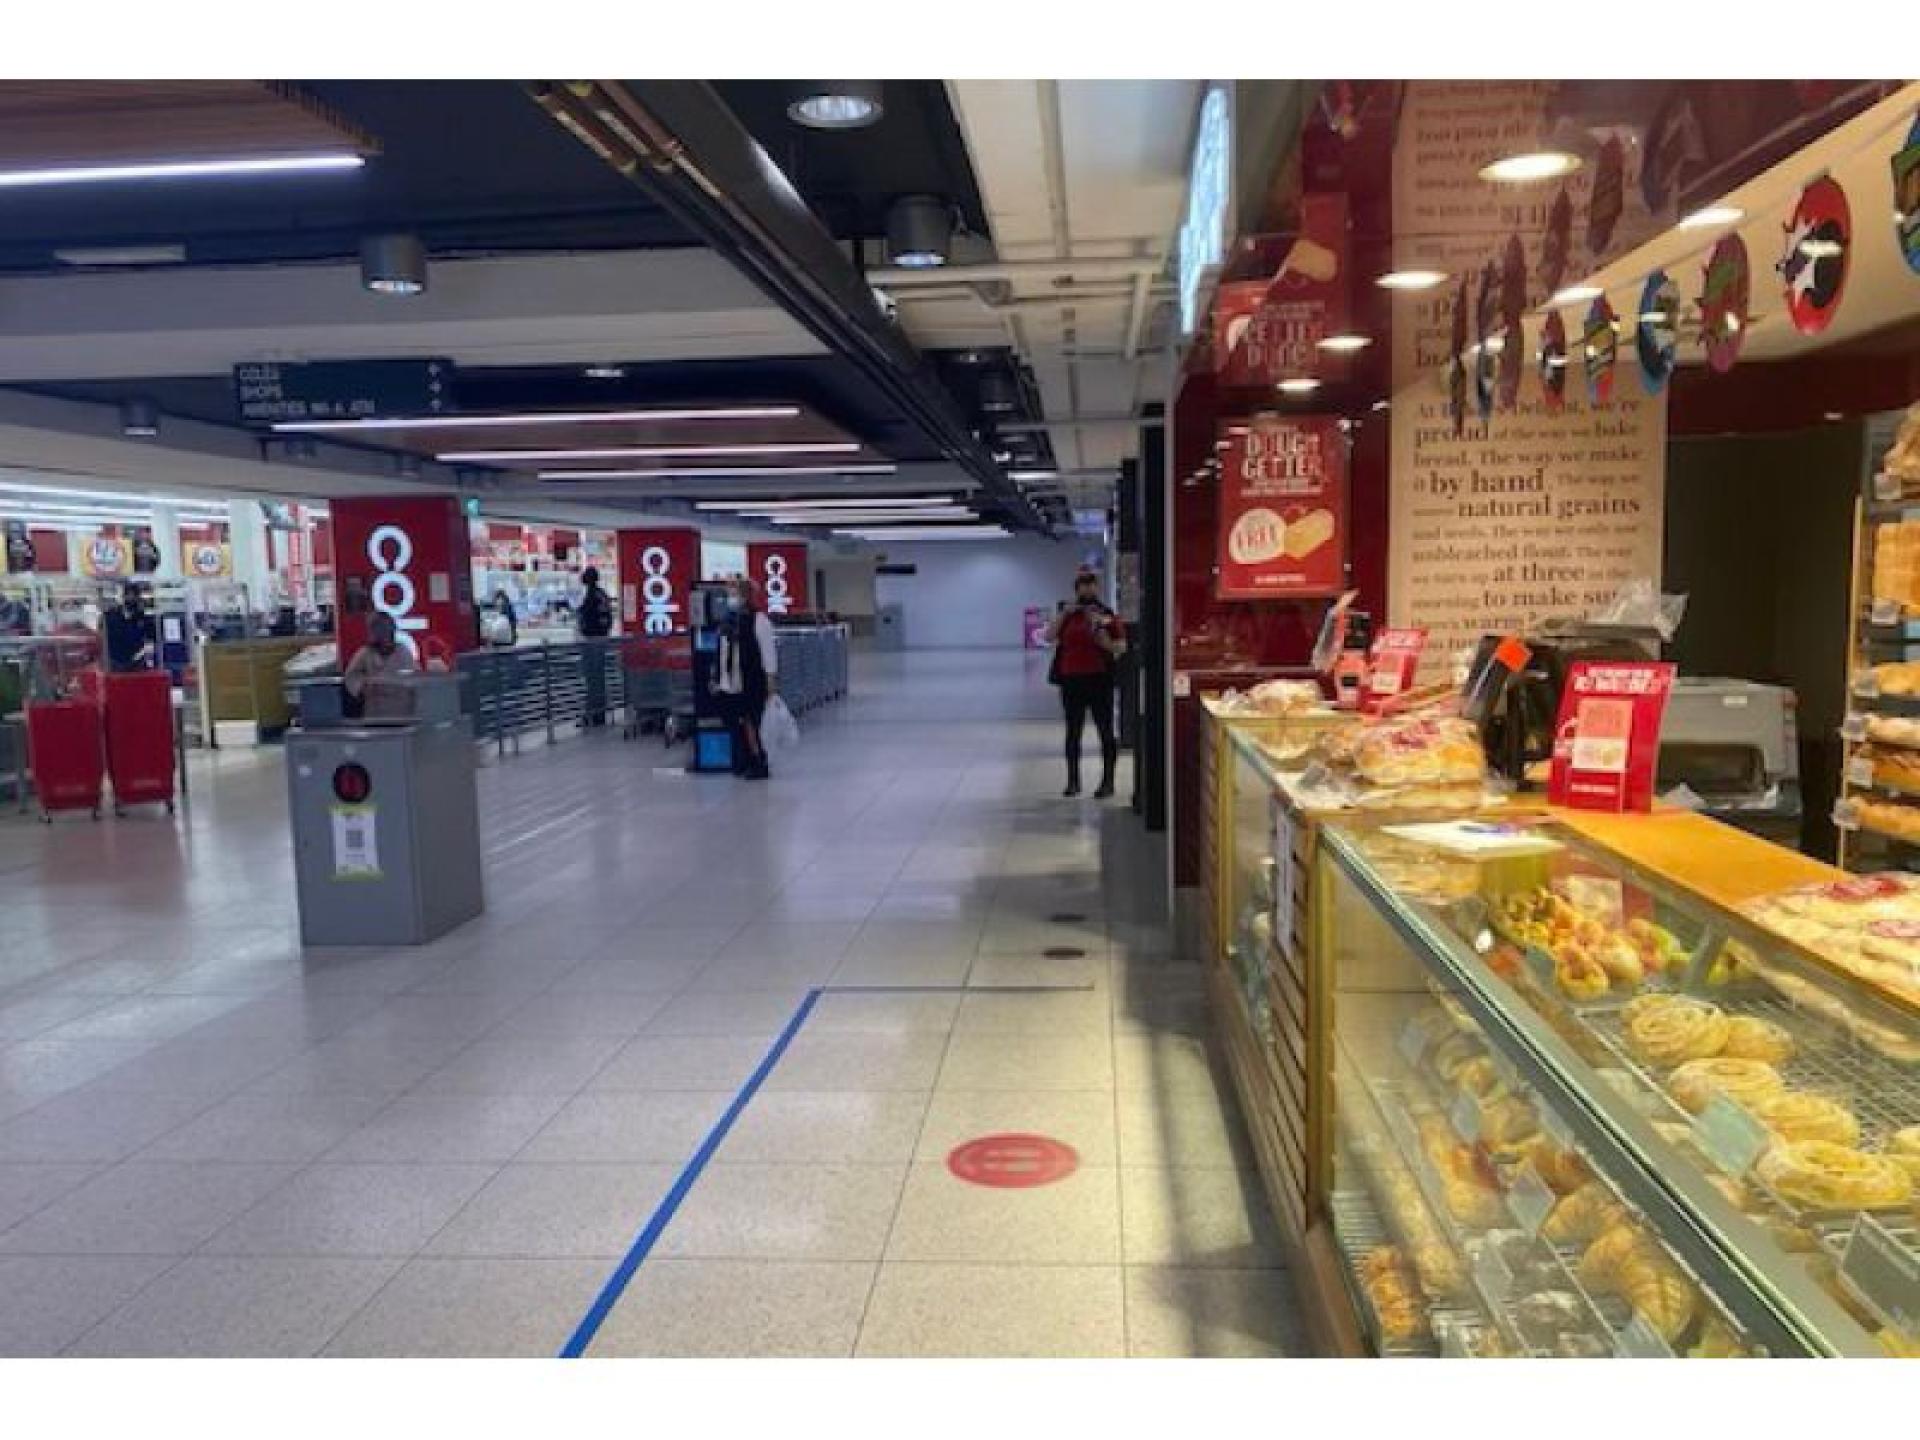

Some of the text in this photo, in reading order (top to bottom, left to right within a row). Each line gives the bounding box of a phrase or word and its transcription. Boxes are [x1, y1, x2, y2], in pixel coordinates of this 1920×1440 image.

[1594, 419, 1639, 438] bake
[1480, 449, 1514, 466] The
[1516, 453, 1553, 470] way
[1558, 452, 1586, 463] we
[1590, 444, 1643, 462] make
[1429, 468, 1464, 501] by
[1458, 494, 1551, 518] natural
[1556, 491, 1641, 521] grains
[1412, 543, 1518, 561] unbleached
[1493, 565, 1514, 582] at
[1522, 562, 1585, 582] three
[1483, 590, 1506, 607] to
[1513, 585, 1577, 606] make
